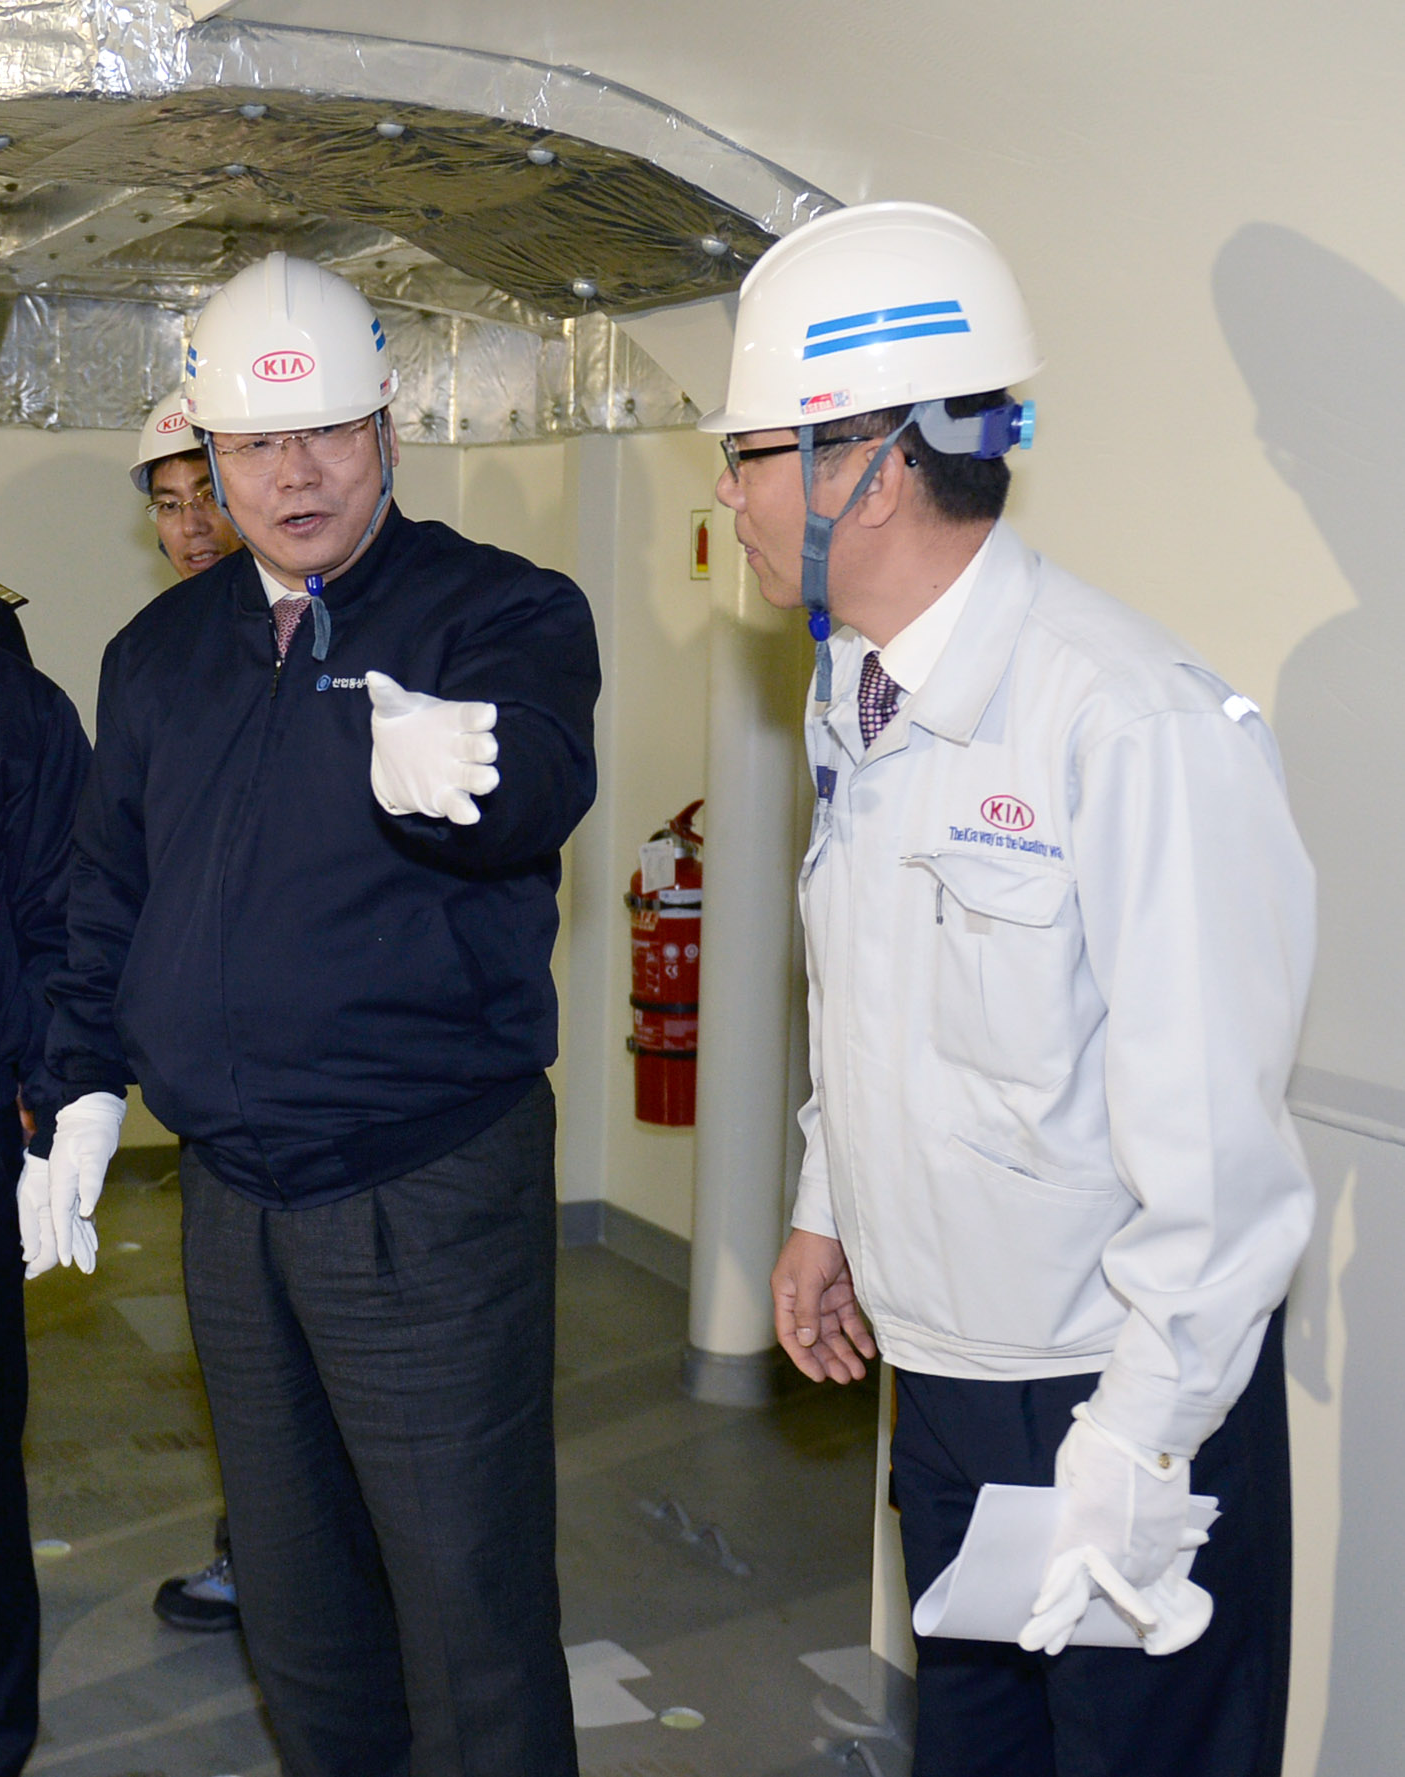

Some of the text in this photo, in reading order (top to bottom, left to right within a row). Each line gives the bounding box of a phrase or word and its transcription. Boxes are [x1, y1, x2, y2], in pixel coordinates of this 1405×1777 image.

[263, 358, 305, 376] KIA
[163, 416, 188, 430] KIA
[990, 800, 1025, 827] KIA
